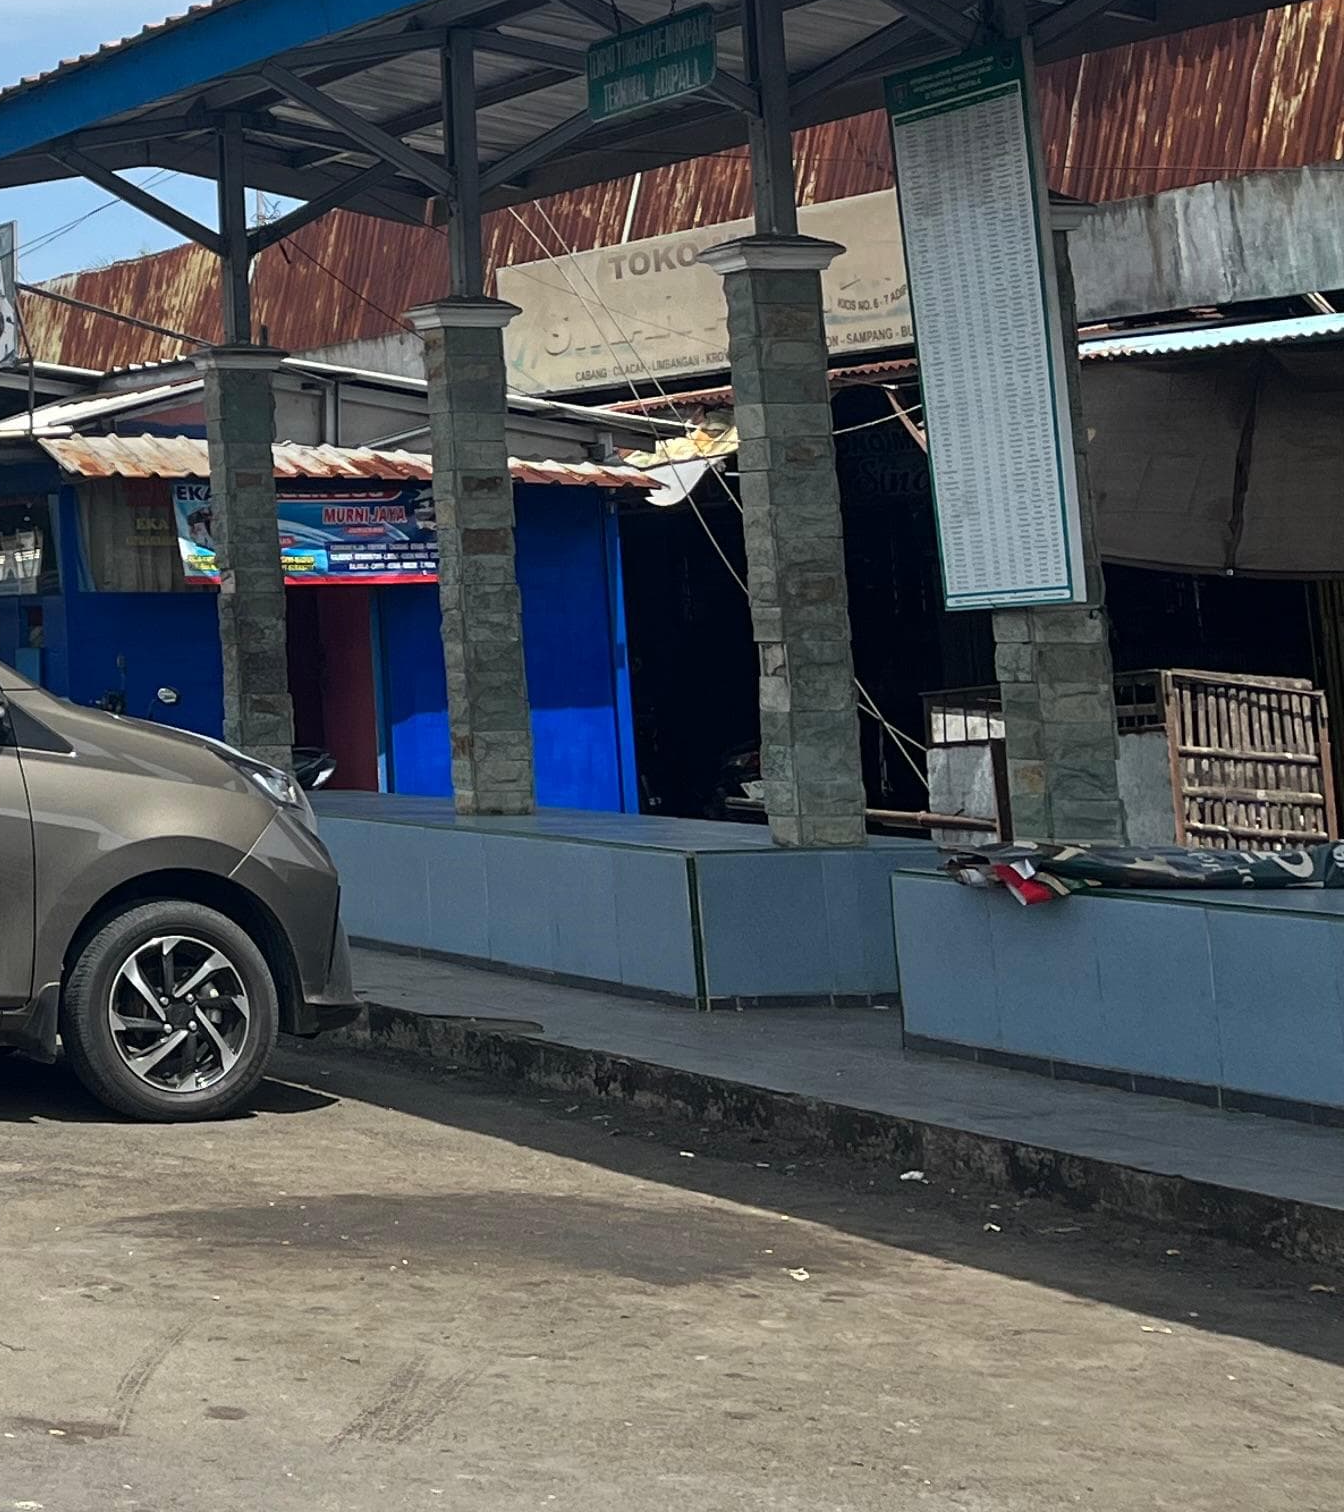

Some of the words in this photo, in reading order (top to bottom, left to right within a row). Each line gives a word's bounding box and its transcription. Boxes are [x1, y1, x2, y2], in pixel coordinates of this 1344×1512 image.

[653, 56, 702, 99] ADIPALA
[608, 241, 699, 279] TOKO
[846, 327, 893, 345] SAMPANG
[323, 506, 368, 524] MURNI
